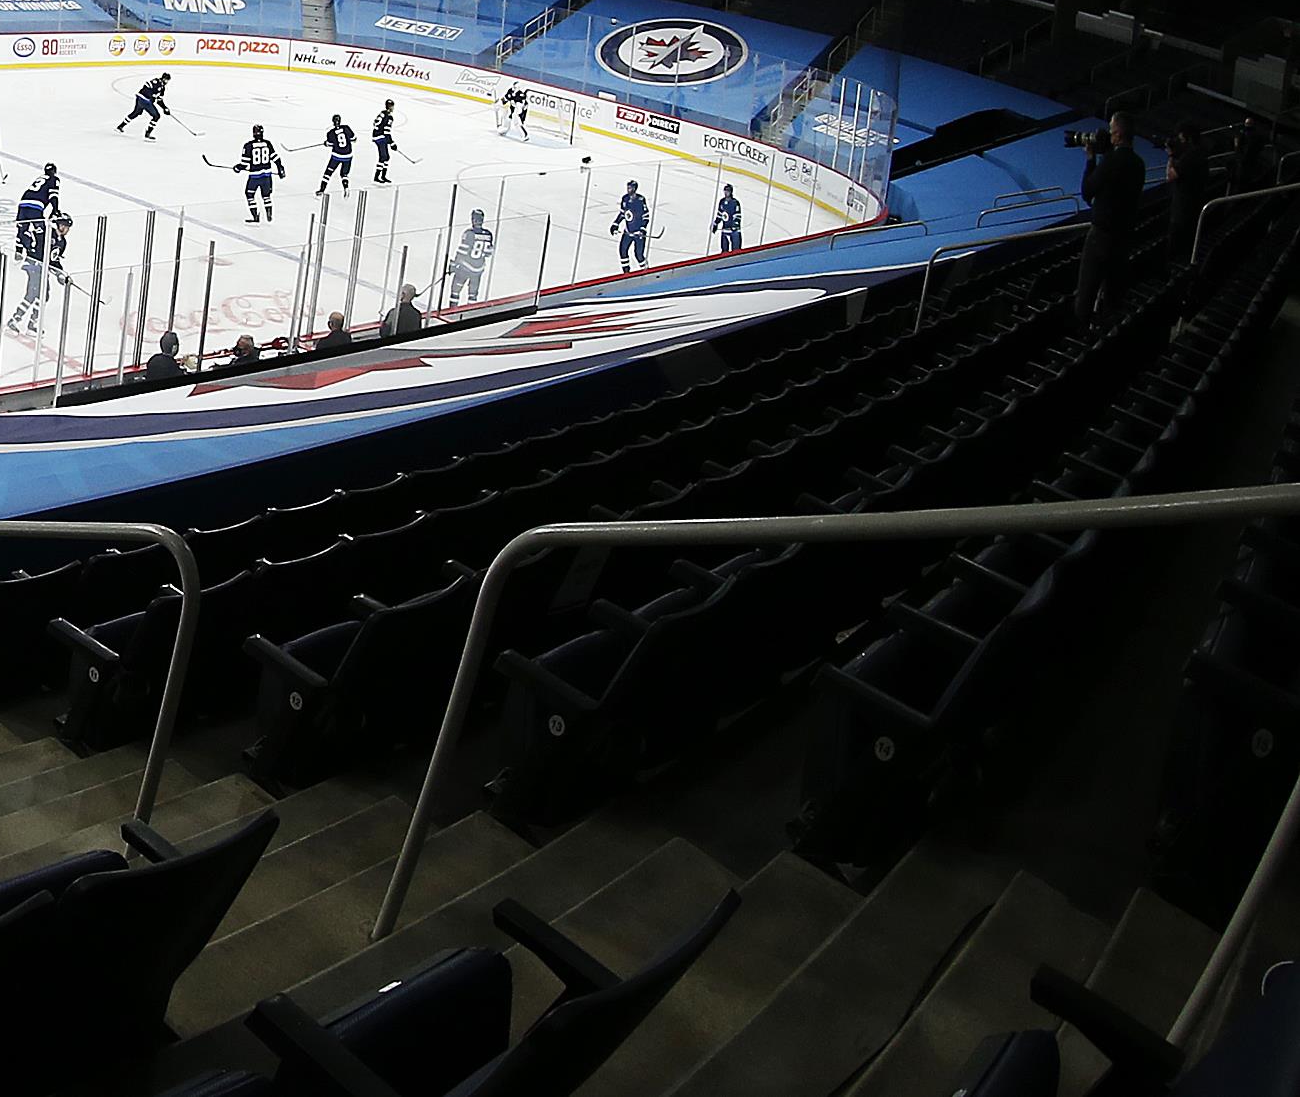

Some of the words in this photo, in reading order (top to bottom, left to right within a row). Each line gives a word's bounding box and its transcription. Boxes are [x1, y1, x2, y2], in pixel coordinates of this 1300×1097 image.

[380, 17, 429, 33] JETS
[42, 39, 58, 55] 80
[196, 38, 235, 54] pizza
[238, 40, 280, 56] pizza
[293, 53, 336, 66] NHL.COM
[345, 50, 371, 71] Tim
[374, 54, 431, 81] Hortons
[618, 107, 644, 124] TSN
[651, 115, 679, 132] DIRECT
[252, 146, 269, 165] 88
[703, 133, 738, 152] FORTY
[738, 141, 769, 167] CREEK
